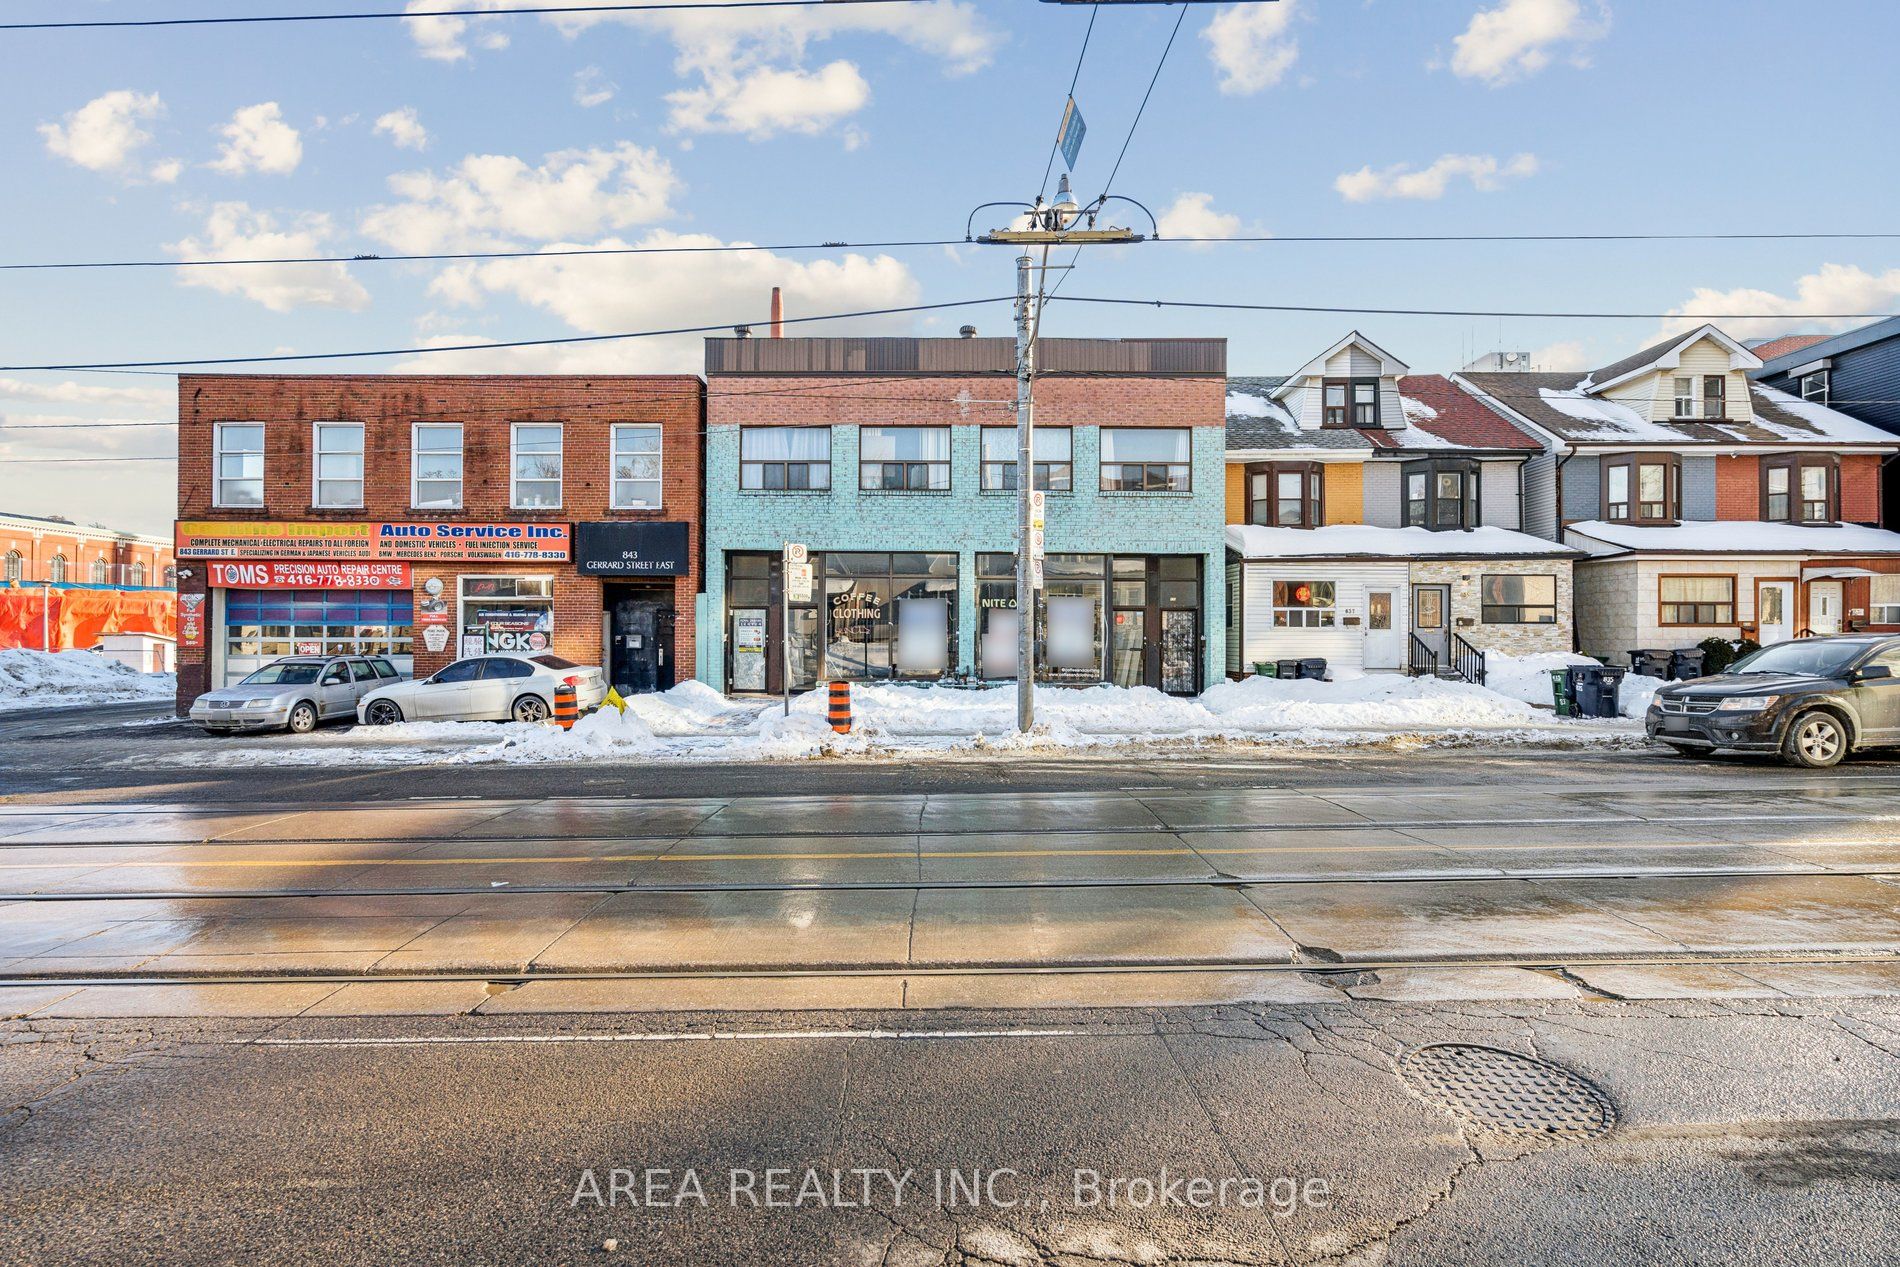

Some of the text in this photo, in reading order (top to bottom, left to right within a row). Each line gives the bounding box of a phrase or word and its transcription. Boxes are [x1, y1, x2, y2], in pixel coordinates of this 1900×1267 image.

[288, 524, 370, 538] Import
[380, 524, 431, 537] Auto
[437, 525, 522, 538] Service
[527, 525, 568, 538] Inc.
[190, 539, 221, 547] COMPLETE
[298, 539, 323, 548] REPAIRS
[324, 540, 332, 548] TO
[333, 540, 343, 548] ALL
[344, 540, 370, 548] FOREIGN
[380, 540, 392, 548] AND
[395, 540, 426, 548] DOMESTIC
[428, 540, 456, 548] VEHICLES
[465, 541, 479, 549] FUEL
[480, 541, 510, 549] INJECTION
[513, 541, 538, 549] SERVICE
[193, 548, 220, 556] GERRARD
[468, 551, 502, 559] VOLKSWAGEN
[504, 551, 566, 559] 416-778-8330
[622, 551, 638, 559] 843
[274, 564, 402, 575] PRECISION AUTO REPAIR CENTRE
[586, 561, 675, 569] GERRARD STREET EAST
[212, 564, 269, 584] TOMS
[288, 575, 379, 587] 416-778-8330
[833, 592, 881, 606] COFFEE
[982, 598, 1006, 608] NITE
[833, 608, 881, 619] CLOTHING
[488, 632, 531, 650] NGK
[300, 645, 320, 654] OPEN
